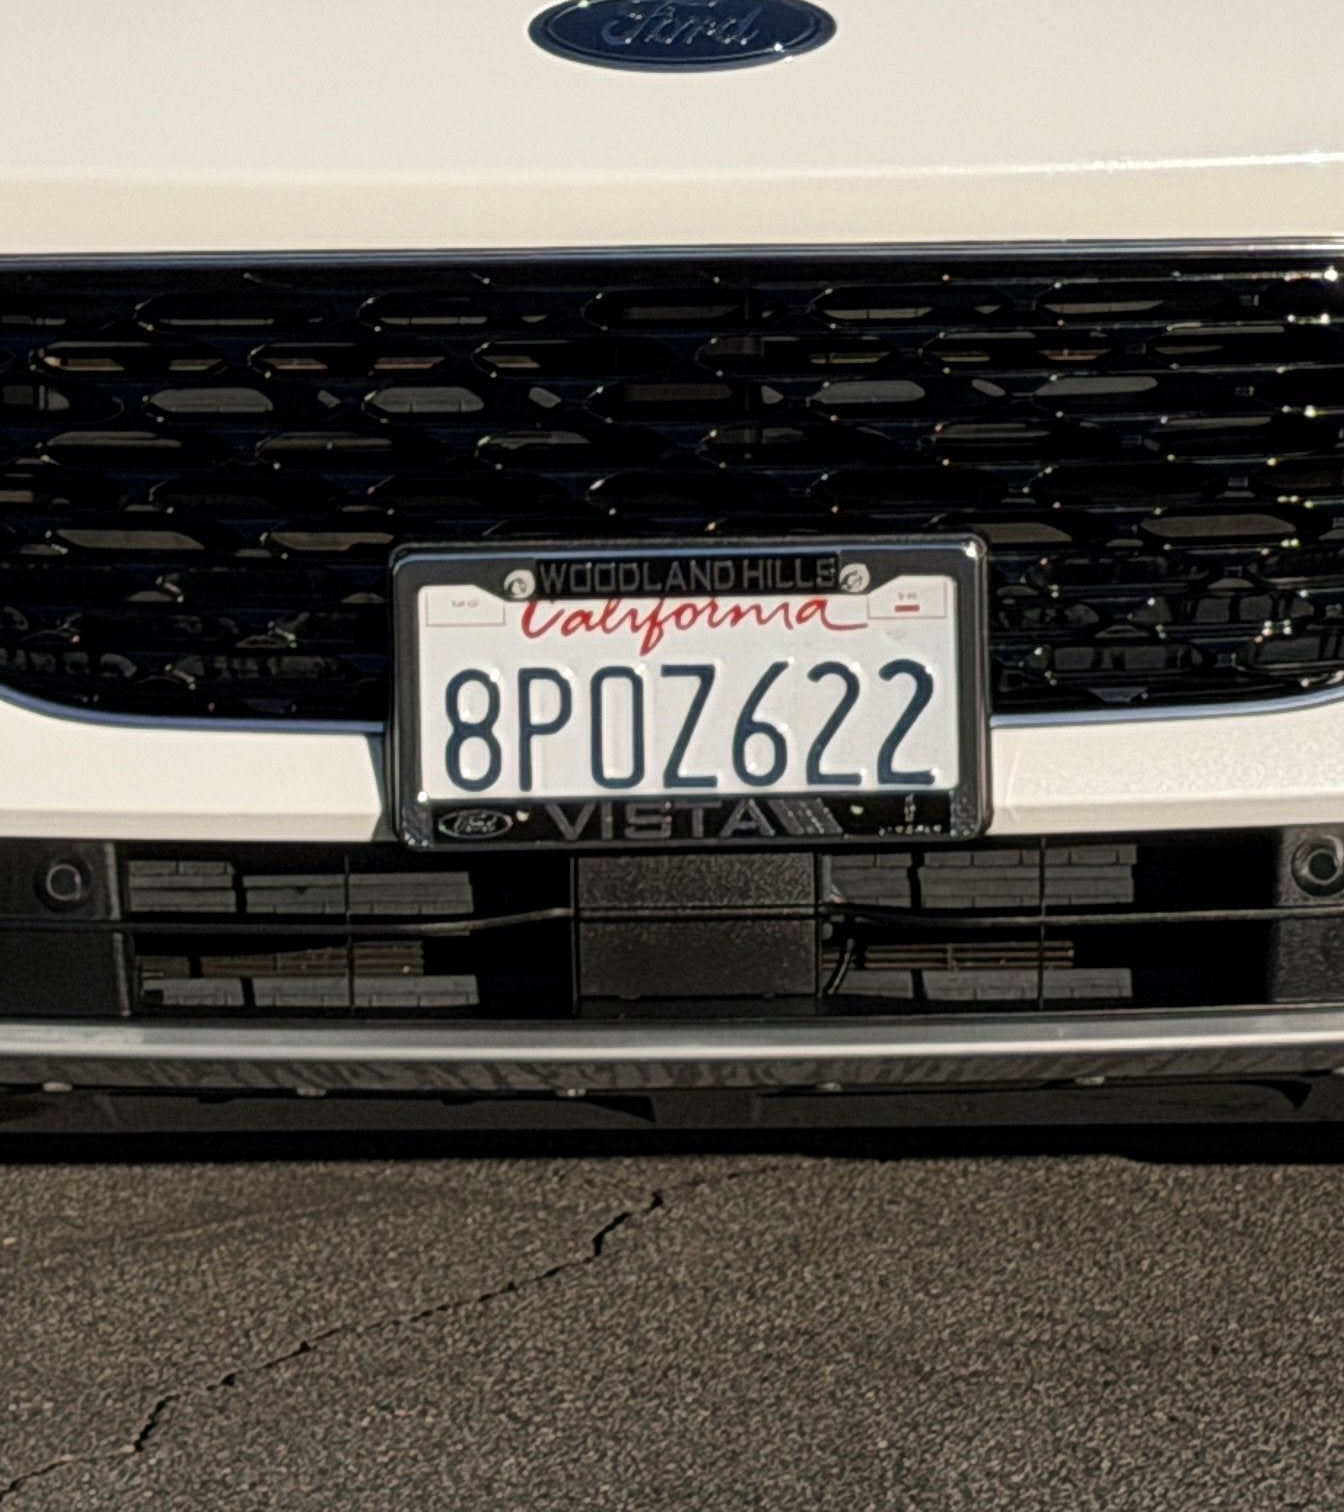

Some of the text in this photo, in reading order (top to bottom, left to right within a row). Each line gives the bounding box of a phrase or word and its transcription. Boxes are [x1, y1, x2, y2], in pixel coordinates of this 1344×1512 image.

[540, 557, 837, 593] WOODLAND HILLS
[521, 597, 869, 657] California
[545, 798, 776, 841] VISTA
